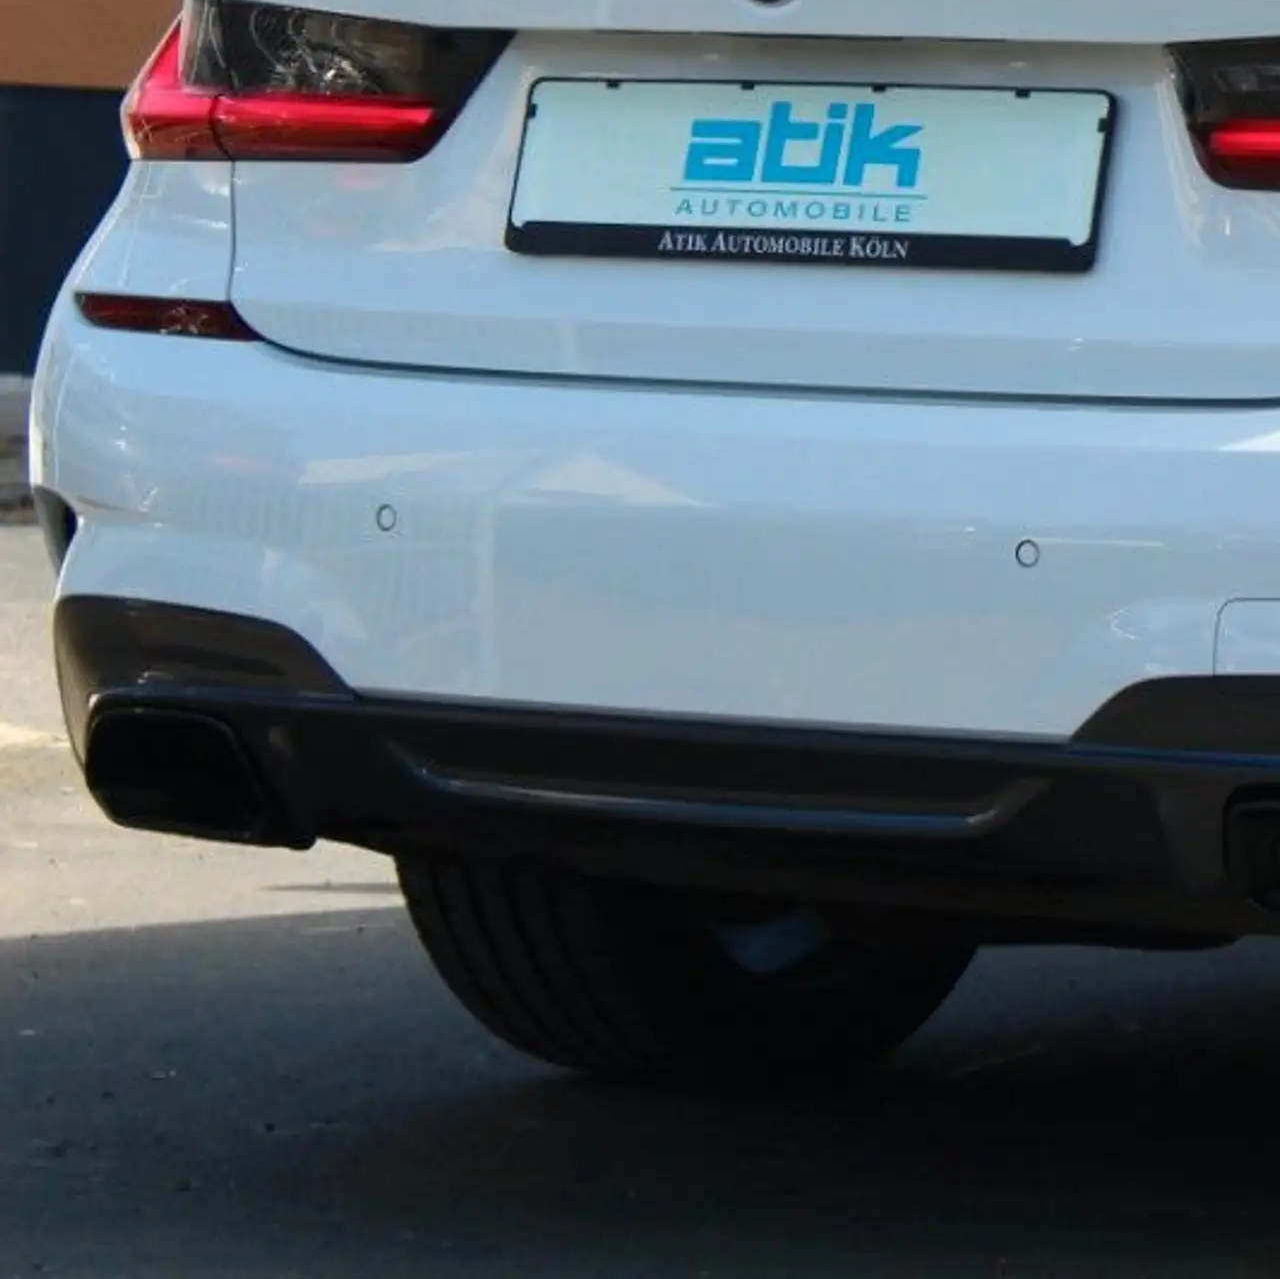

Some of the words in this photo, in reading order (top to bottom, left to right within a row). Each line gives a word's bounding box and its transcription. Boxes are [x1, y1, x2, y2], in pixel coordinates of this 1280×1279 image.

[683, 100, 924, 189] atik
[674, 196, 912, 223] AUTOMOBILE
[710, 231, 844, 257] AUTOMOBILE
[848, 234, 909, 259] KÖLN
